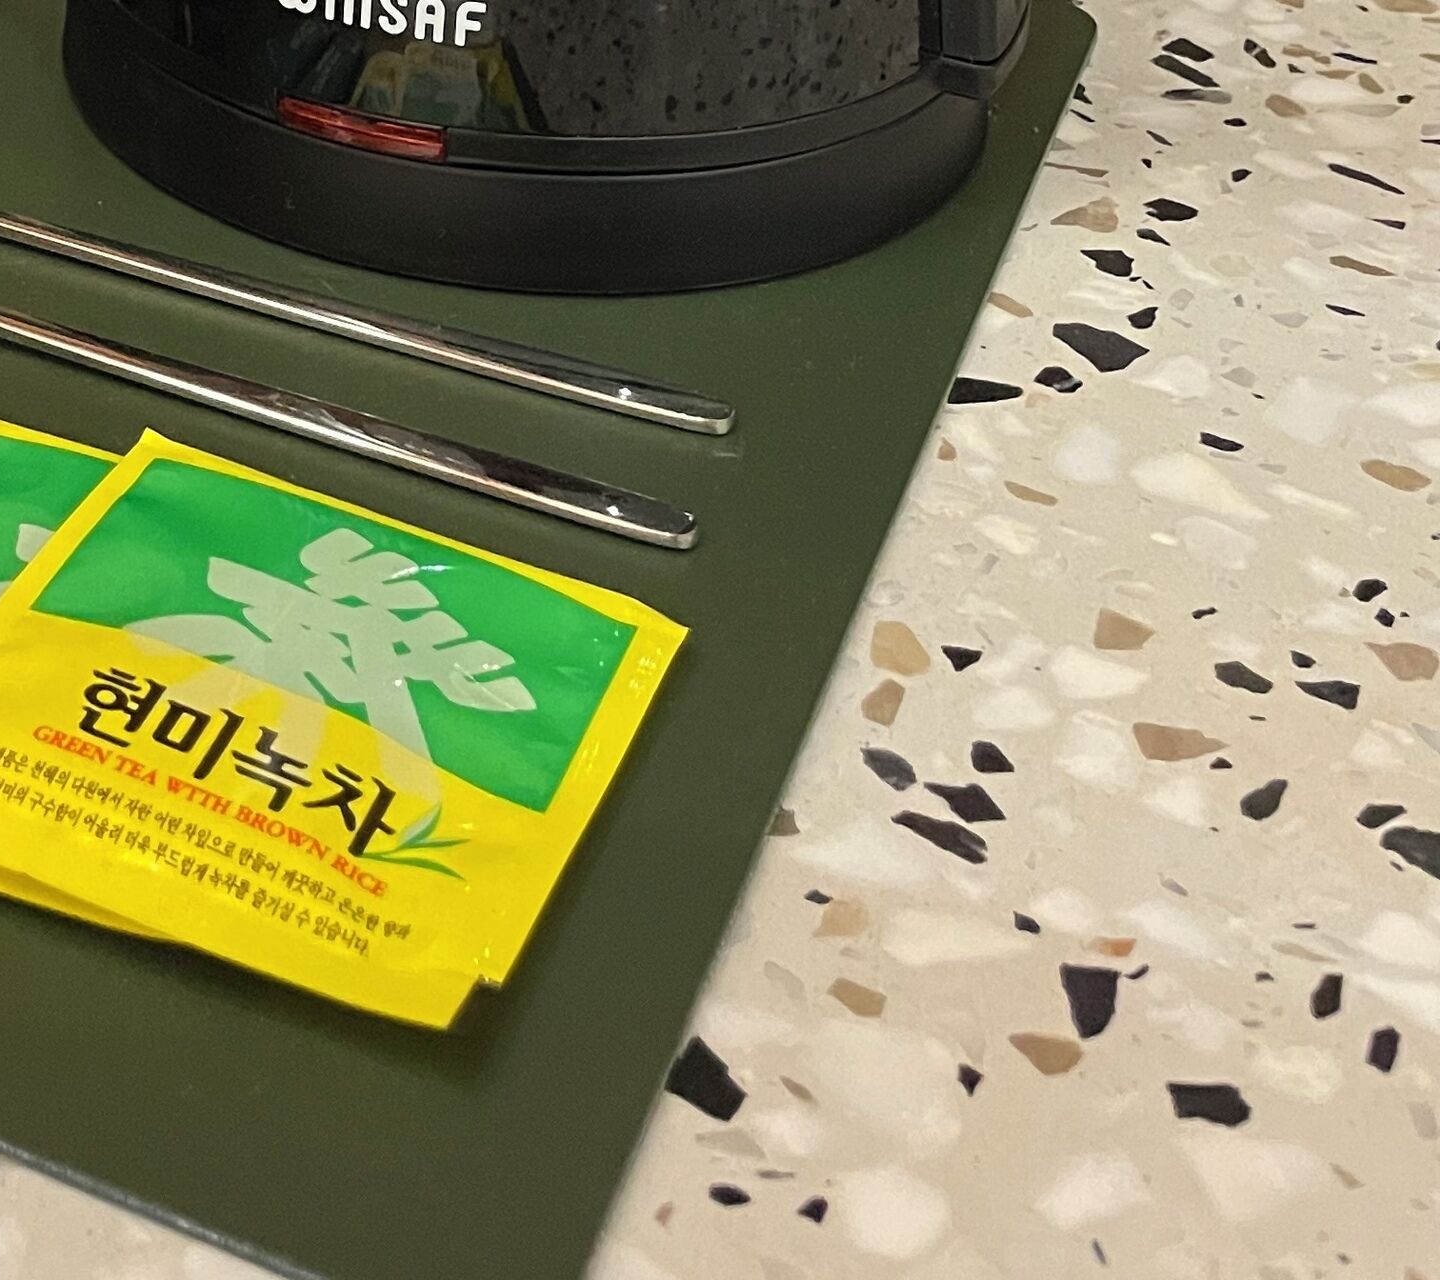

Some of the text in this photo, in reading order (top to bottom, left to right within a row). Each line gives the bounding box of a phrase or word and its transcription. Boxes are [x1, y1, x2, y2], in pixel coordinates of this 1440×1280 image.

[33, 725, 388, 898] GREEN TEA WITH BROWN RICE
[79, 667, 396, 857] 현미녹차
